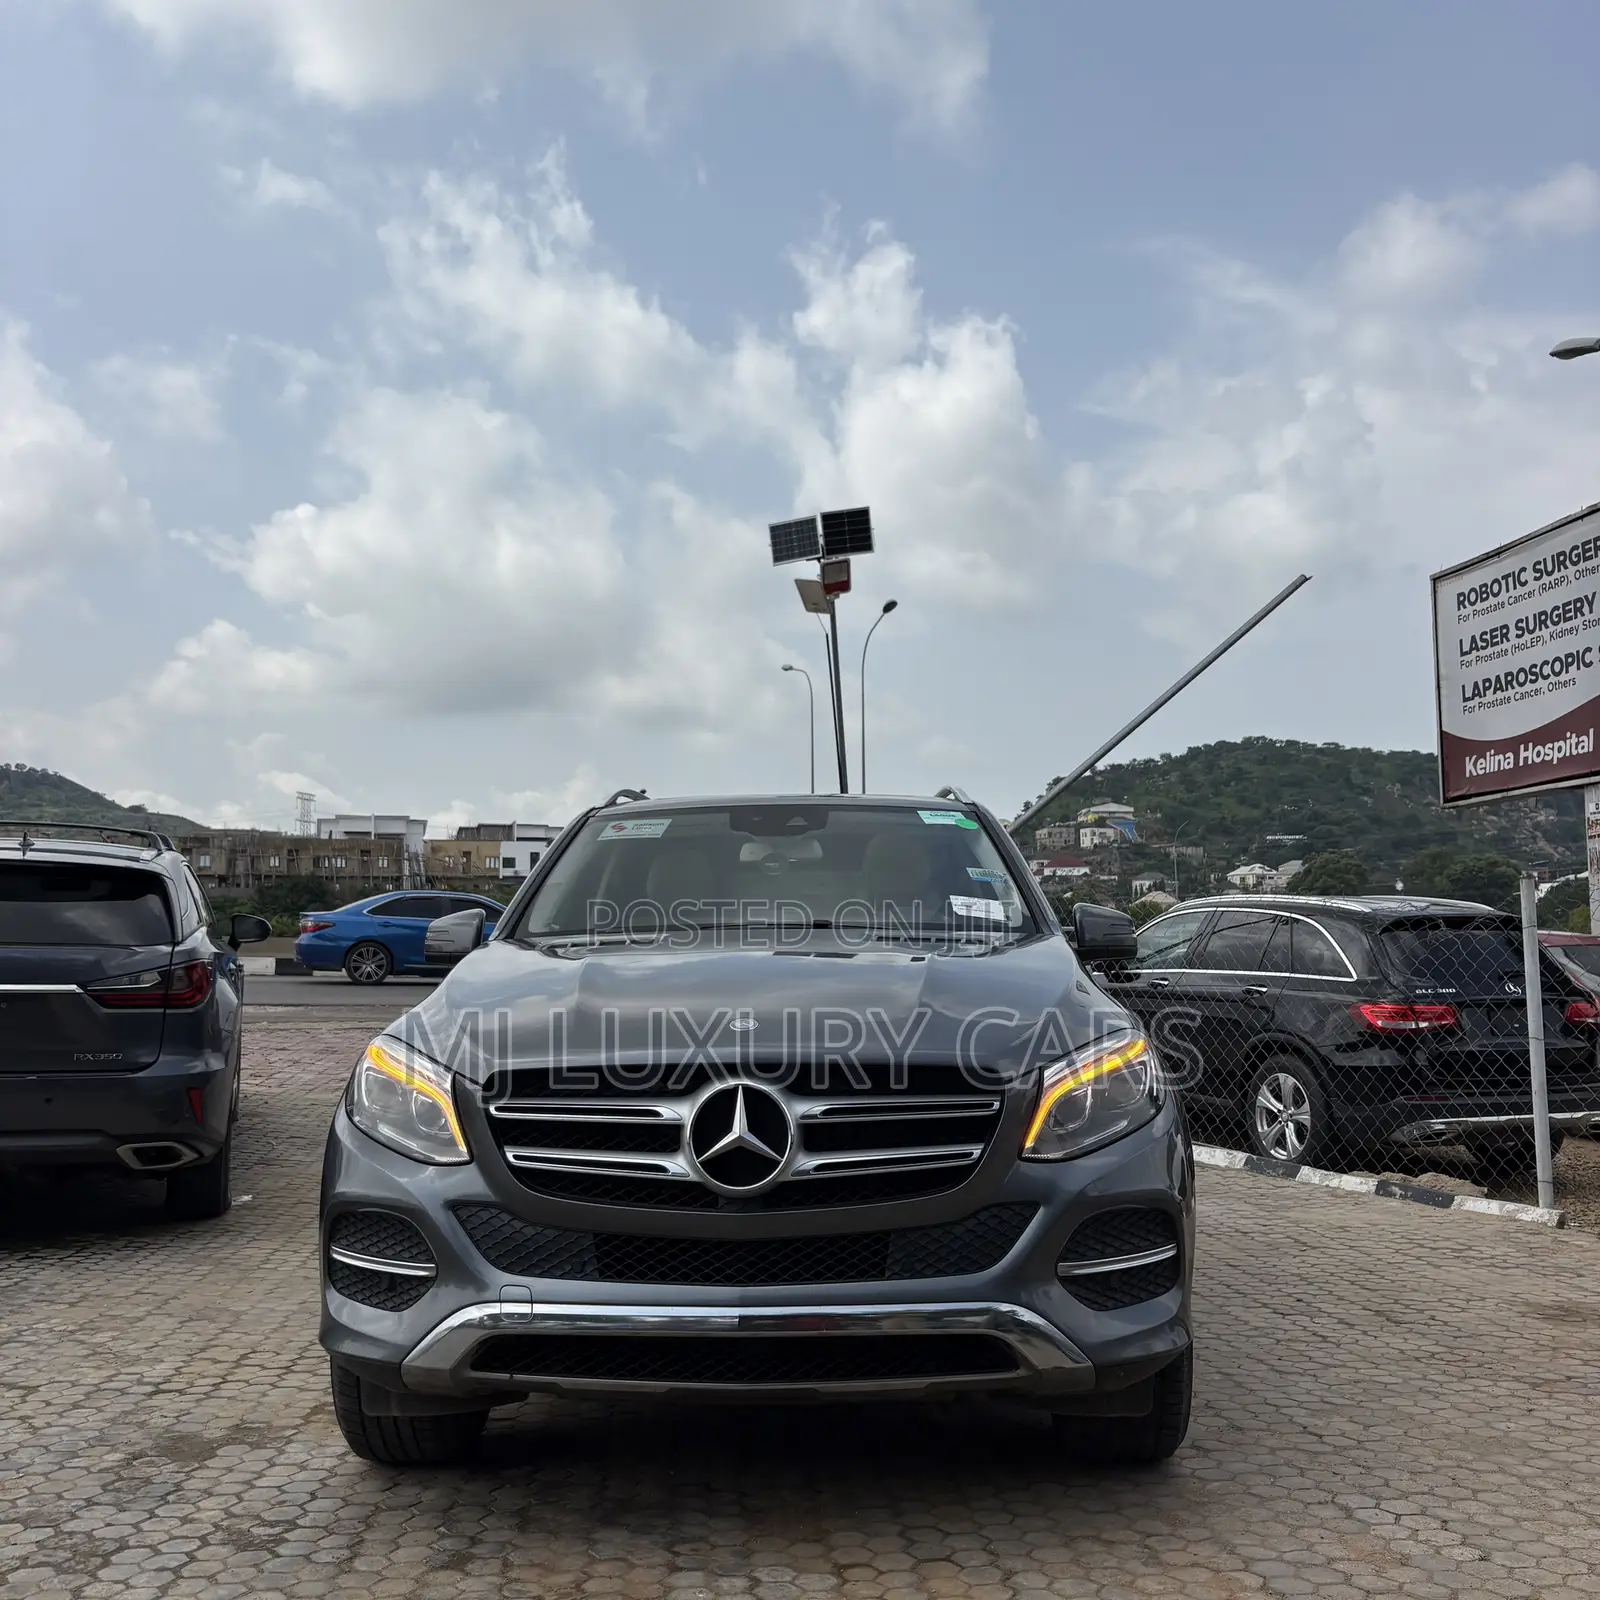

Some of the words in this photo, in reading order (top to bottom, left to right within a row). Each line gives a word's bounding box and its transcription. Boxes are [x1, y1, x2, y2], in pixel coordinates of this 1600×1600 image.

[1456, 566, 1528, 611] ROBOTIC
[1457, 613, 1471, 624] For
[1472, 600, 1505, 619] Prostate
[1507, 588, 1536, 606] Cancer
[1538, 574, 1572, 596] (RARP),
[1458, 623, 1511, 657] LASER
[1514, 591, 1597, 639] SURGERY
[1460, 659, 1473, 670] For
[1475, 648, 1509, 666] Prostate
[1511, 634, 1547, 656] (HoLEP),
[1549, 624, 1580, 642] Kidney
[1461, 646, 1594, 703] LAPAROSCOPIC
[1462, 705, 1476, 715] For
[1478, 695, 1511, 712] Prostate
[1513, 686, 1545, 702] Cancer,
[1547, 677, 1577, 693] Others
[1465, 749, 1514, 778] Kelina
[1519, 728, 1594, 767] Hospital
